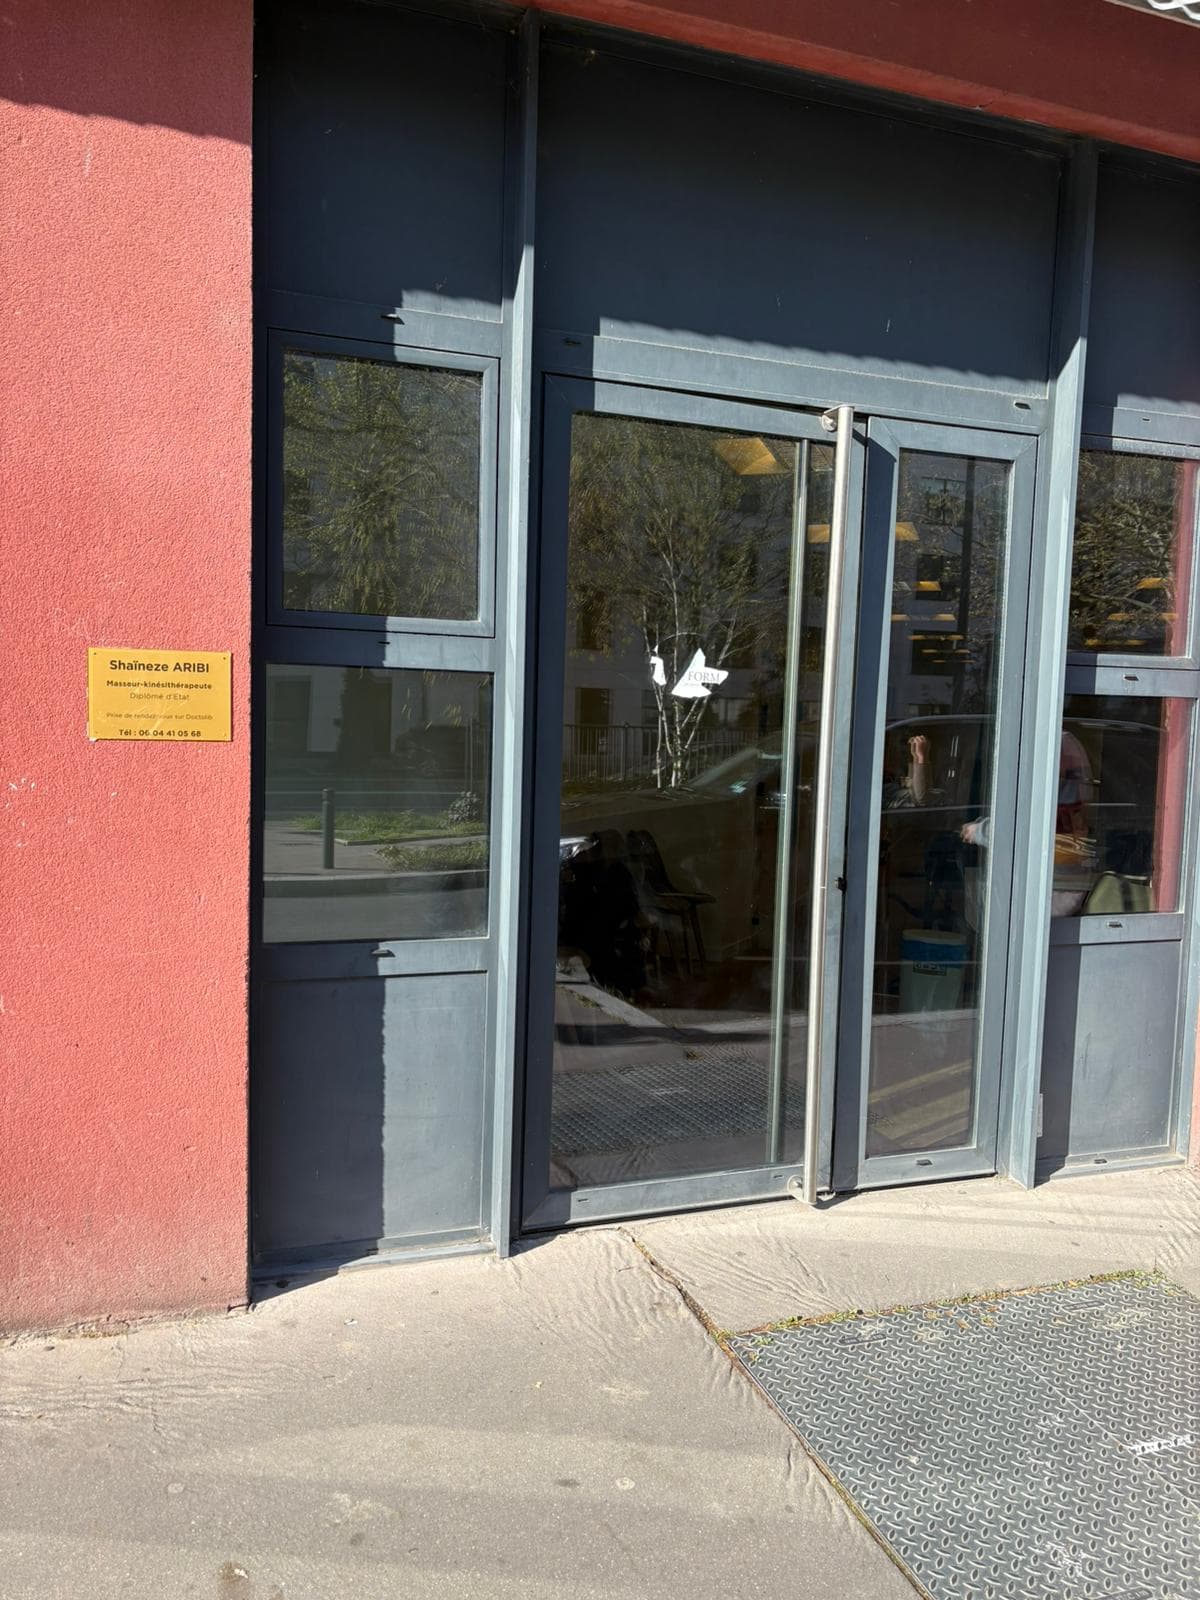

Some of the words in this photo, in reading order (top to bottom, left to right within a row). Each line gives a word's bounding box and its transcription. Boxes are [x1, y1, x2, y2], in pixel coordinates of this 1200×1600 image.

[109, 660, 169, 672] Shaïneze
[173, 662, 209, 673] ARIBI
[106, 680, 212, 690] Masseur-kinésithérapeute
[130, 692, 164, 701] Diplômé
[139, 729, 150, 737] 06
[191, 730, 202, 738] 68
